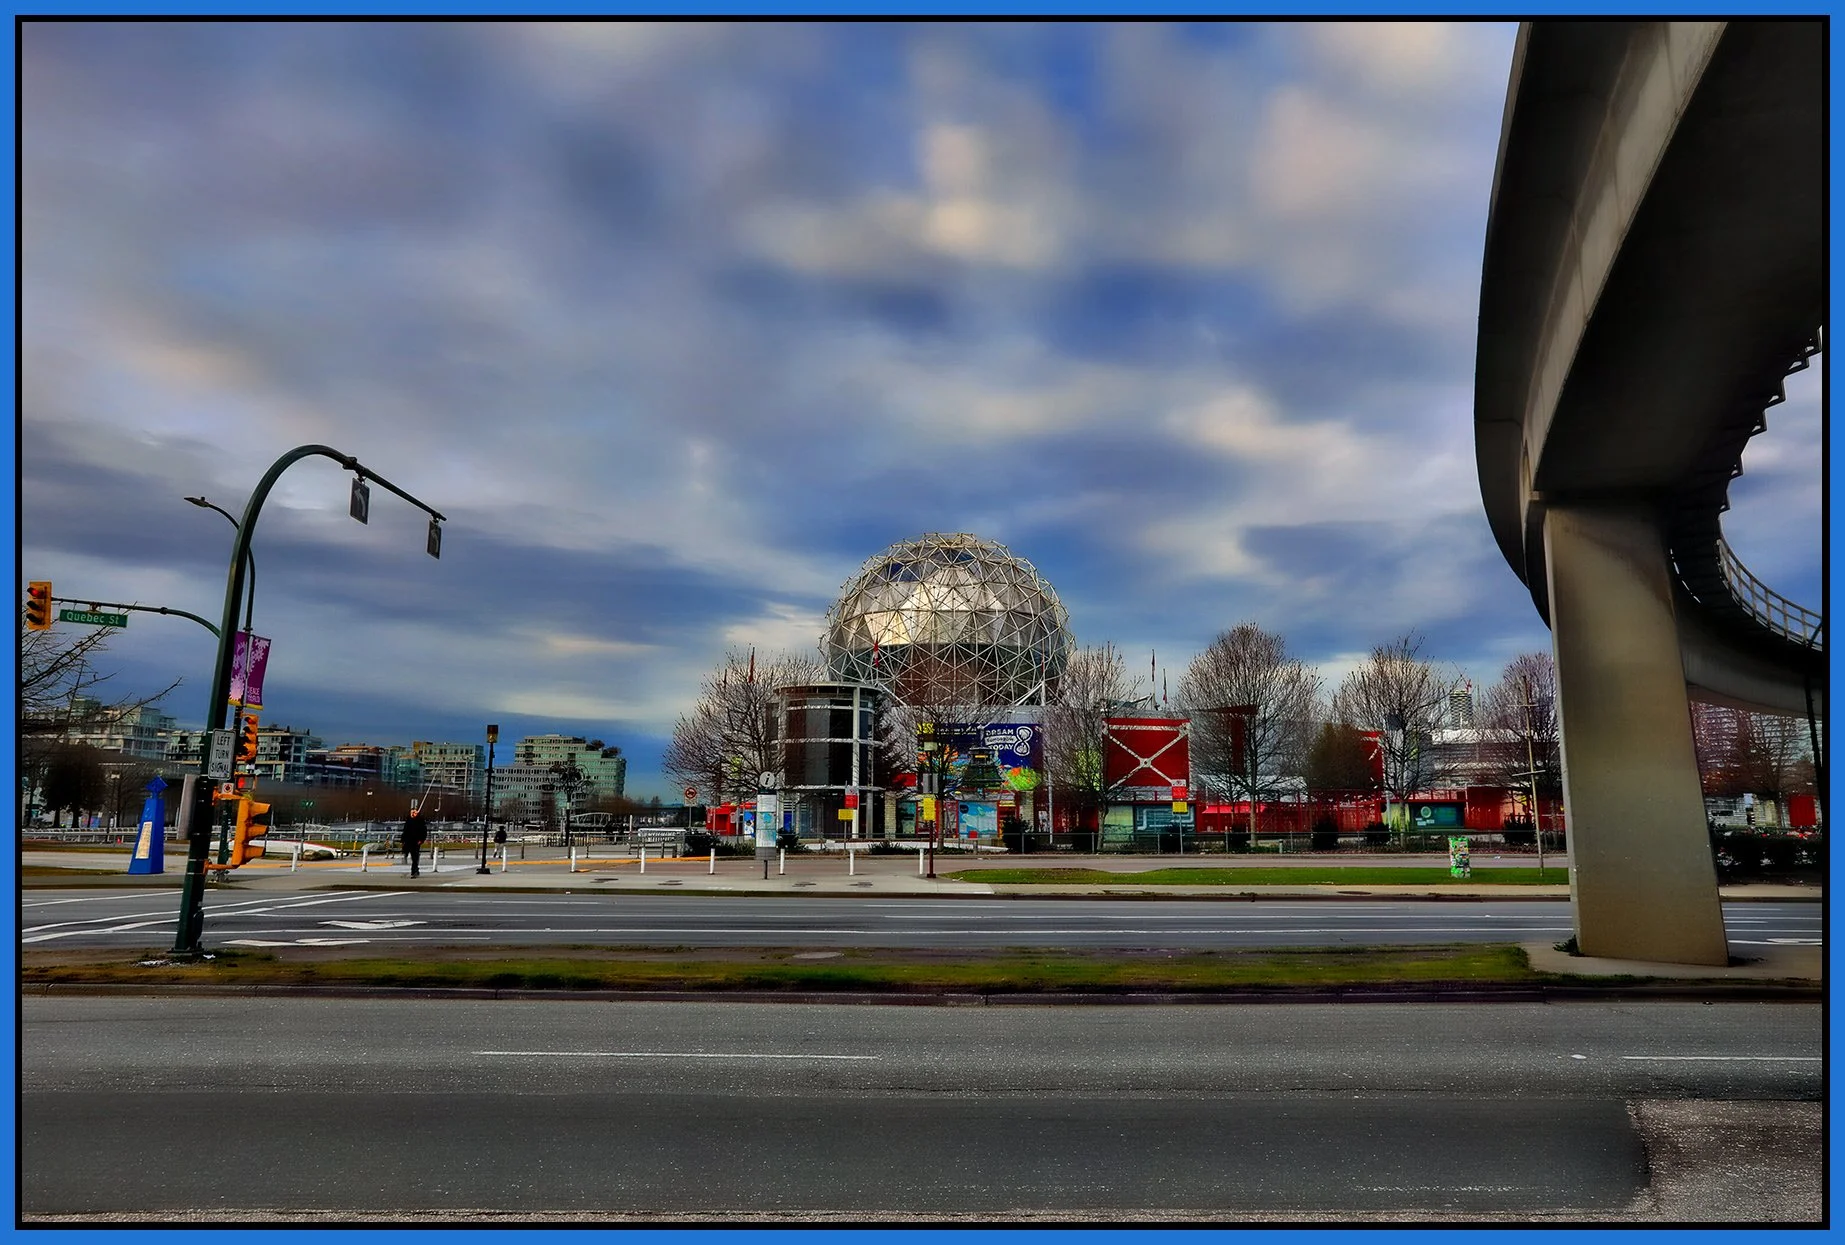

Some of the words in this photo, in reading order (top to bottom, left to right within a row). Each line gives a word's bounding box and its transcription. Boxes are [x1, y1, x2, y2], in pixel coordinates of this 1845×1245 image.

[66, 611, 105, 624] Quebec
[108, 615, 119, 625] St
[985, 728, 1014, 736] DREAM
[216, 735, 231, 746] LEFT
[987, 743, 1014, 751] TODAY
[215, 749, 230, 759] TURN
[210, 762, 230, 773] SIGNAL
